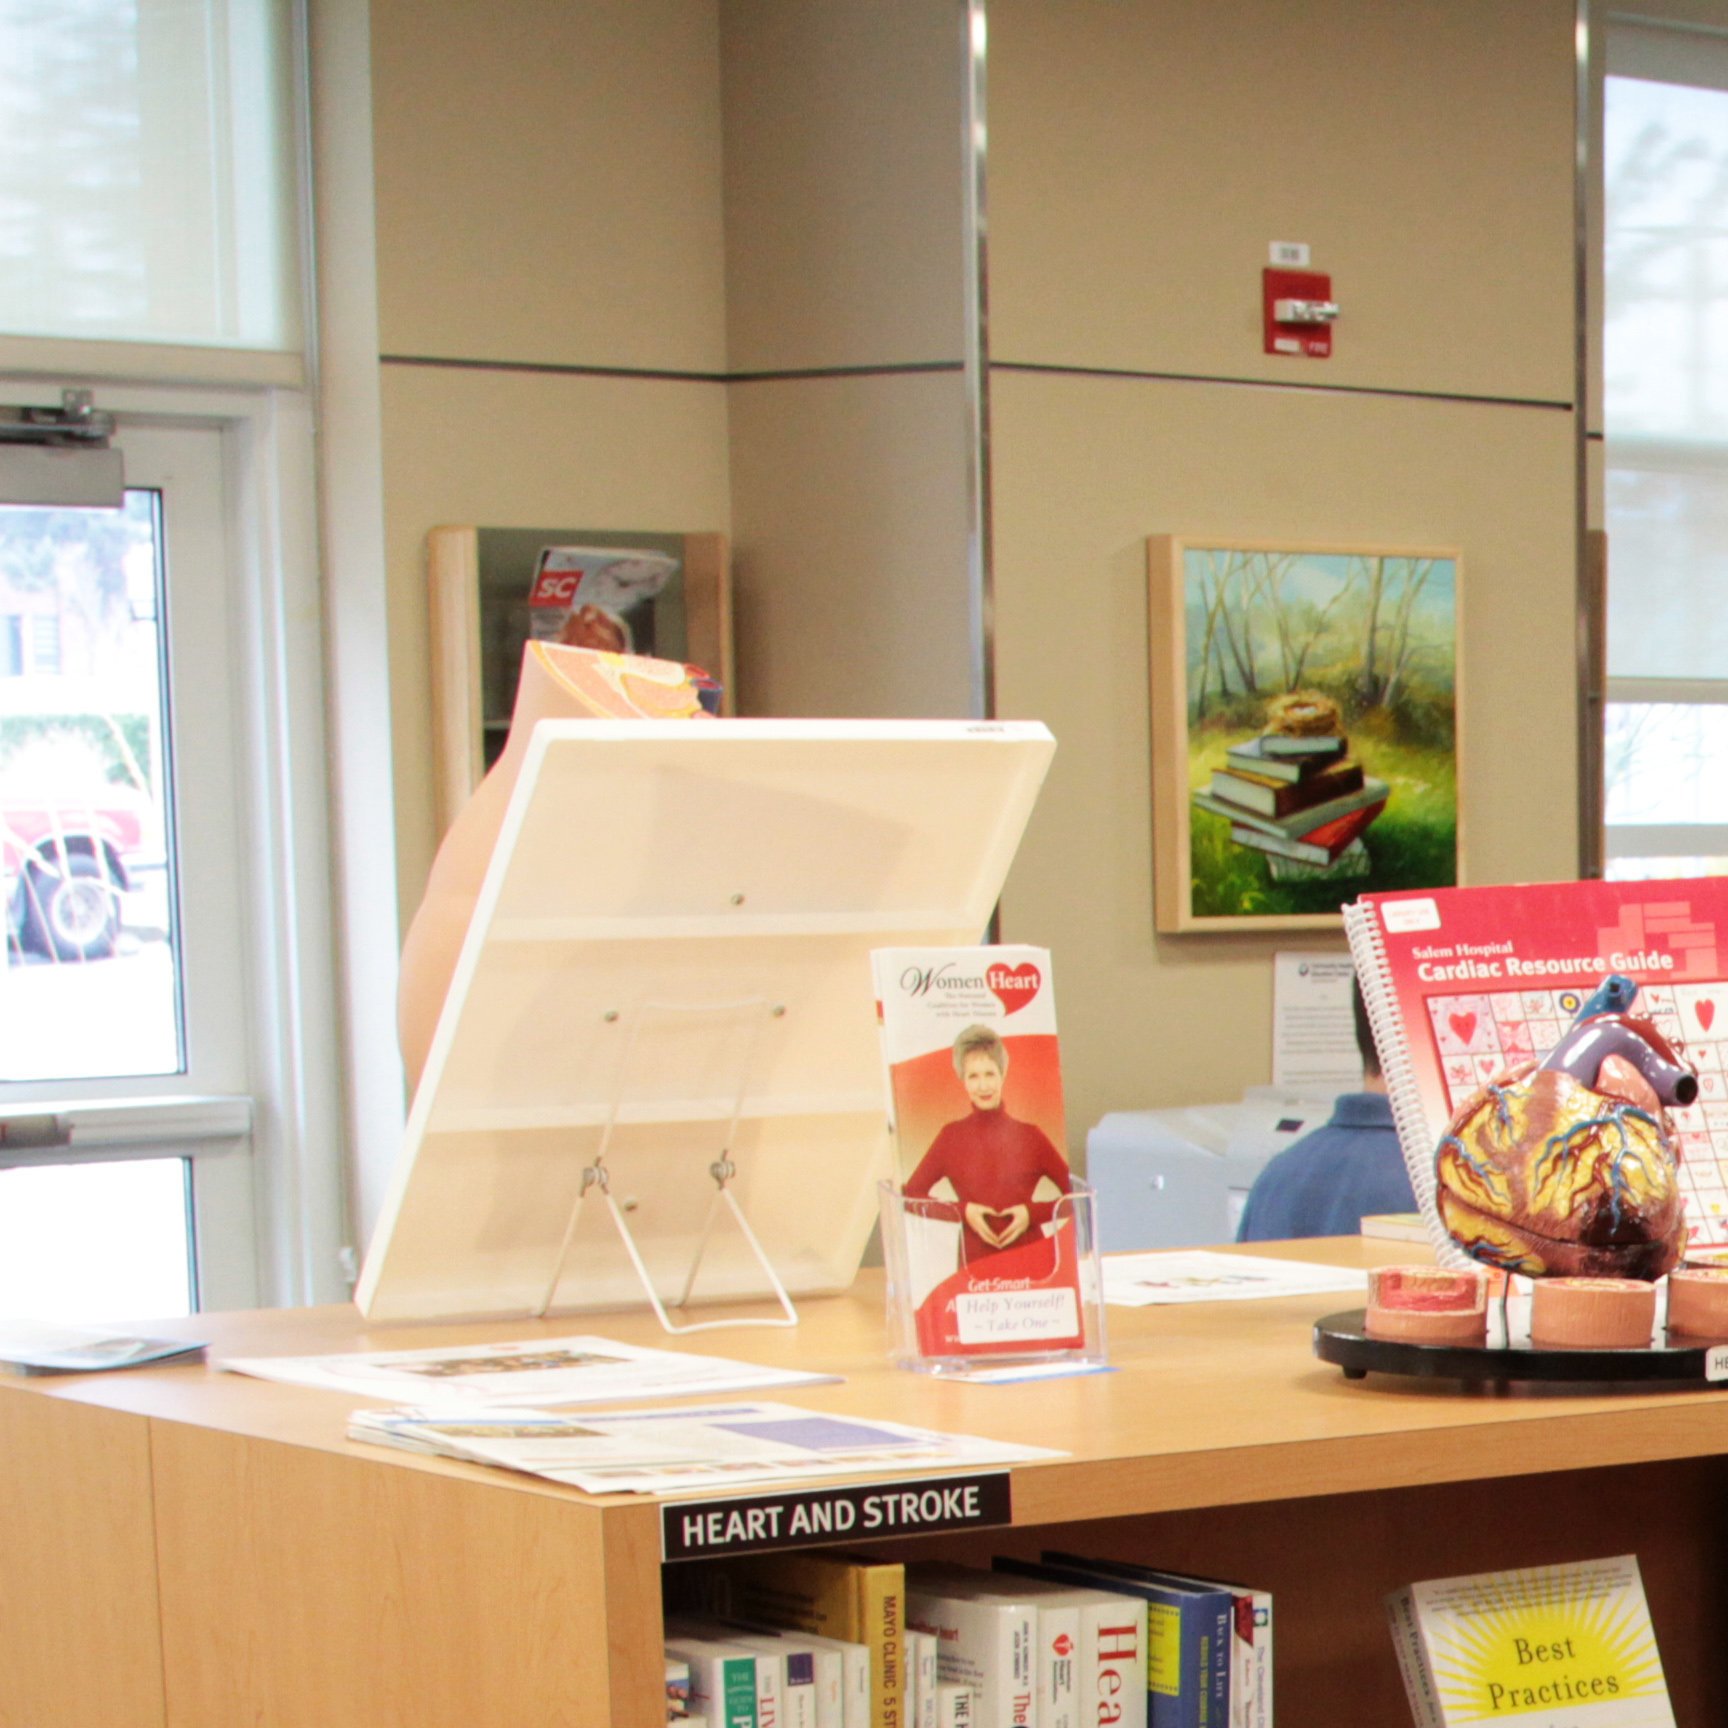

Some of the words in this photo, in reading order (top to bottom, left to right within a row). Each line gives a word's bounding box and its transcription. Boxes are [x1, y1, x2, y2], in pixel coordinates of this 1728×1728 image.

[1412, 943, 1453, 959] Salem
[1456, 940, 1513, 958] Hospital
[901, 962, 985, 997] Women
[988, 970, 1040, 991] Heart
[1418, 957, 1503, 982] Cardiac
[1507, 954, 1605, 978] Resource
[1610, 950, 1673, 971] Guide
[967, 1297, 998, 1314] Help
[1003, 1294, 1065, 1313] Yourself!
[986, 1317, 1019, 1333] Take
[1023, 1317, 1049, 1330] One
[682, 1506, 784, 1547] HEART
[789, 1501, 857, 1534] AND
[862, 1486, 981, 1529] STROKE
[883, 1596, 896, 1637] MAYO
[883, 1641, 896, 1688] CLINIC
[1514, 1637, 1576, 1665] Best
[884, 1697, 896, 1706] 5
[955, 1693, 969, 1716] THE
[1488, 1672, 1620, 1710] Practices
[1013, 1692, 1031, 1724] The
